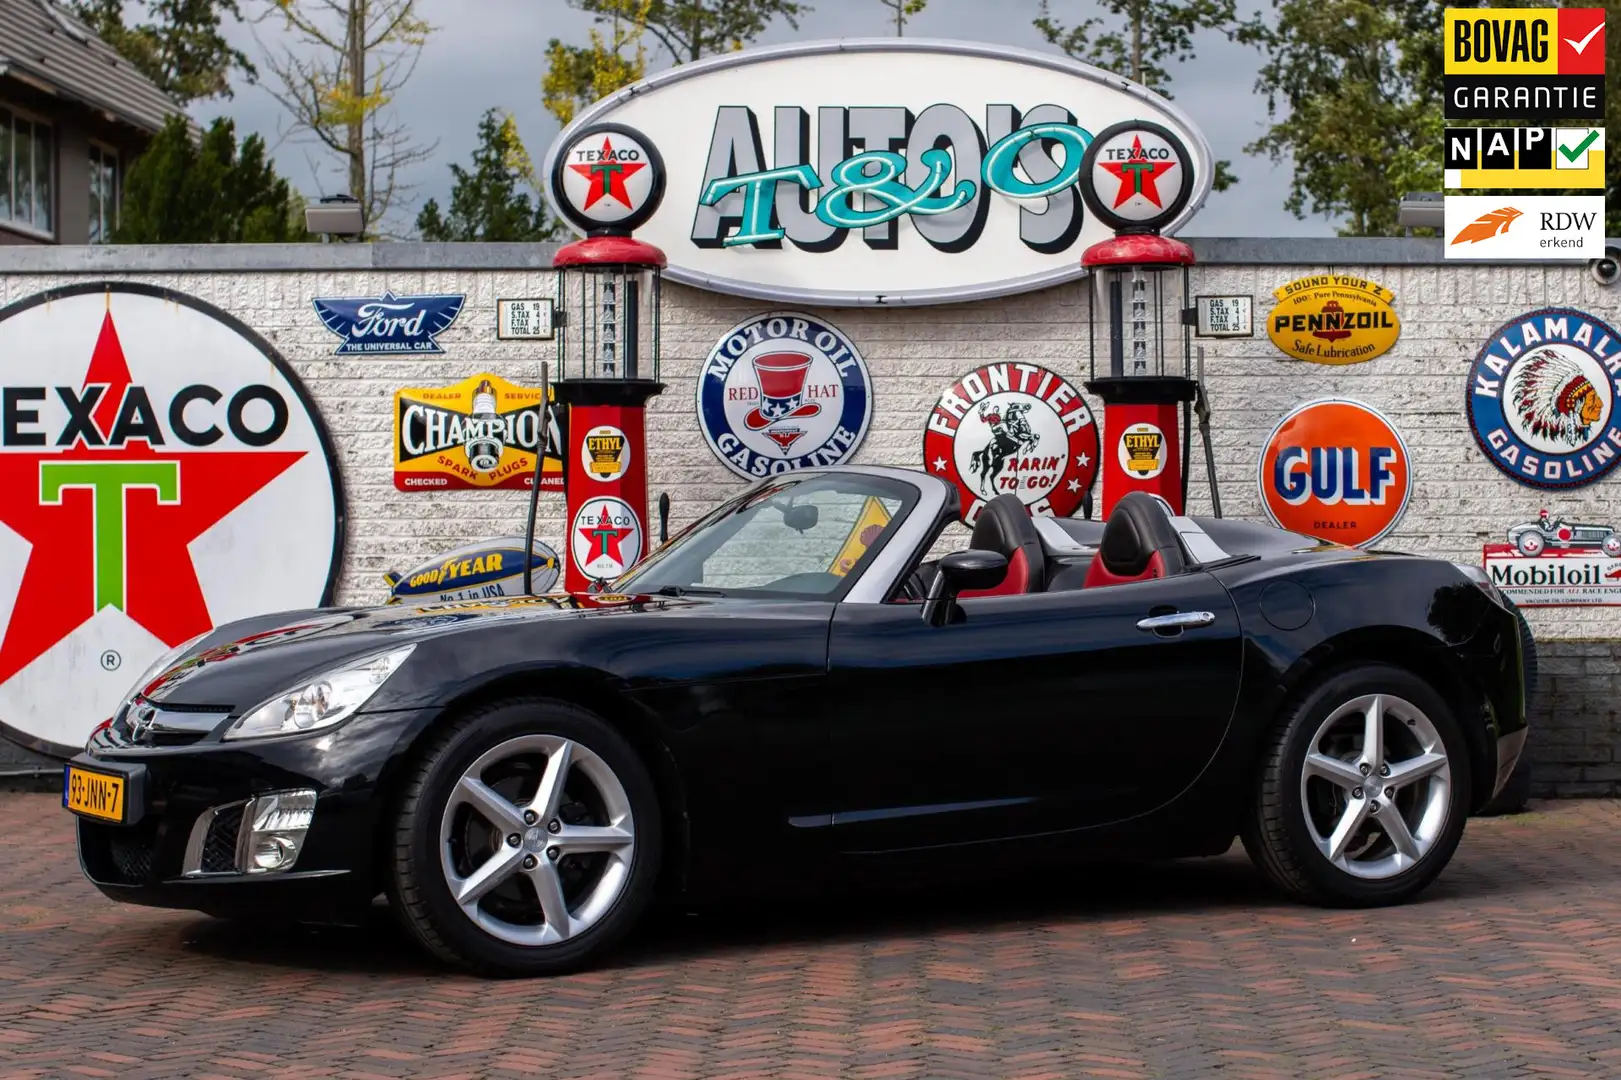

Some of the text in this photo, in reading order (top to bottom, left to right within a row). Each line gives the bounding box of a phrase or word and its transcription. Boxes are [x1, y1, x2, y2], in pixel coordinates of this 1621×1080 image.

[576, 149, 640, 162] TEXACO
[1105, 147, 1170, 160] TEXACO
[690, 103, 1084, 253] AUTO'S
[1284, 276, 1383, 295] SOUND YOUR Z
[511, 303, 525, 311] GAS
[1210, 299, 1239, 307] GAS 19
[1314, 291, 1331, 299] Pure
[1332, 291, 1377, 307] Pennsylvania
[511, 311, 540, 319] S.TAX 4
[1210, 307, 1239, 315] S.TAX 4
[1210, 315, 1228, 323] F.TAX
[351, 302, 428, 338] Ford
[511, 319, 529, 327] F.TAX
[1210, 324, 1230, 332] TOTAL
[1275, 311, 1394, 333] PENNZOIL
[511, 327, 531, 335] TOTAL
[346, 341, 433, 351] THE UNIVERSAL CAR
[708, 317, 857, 382] MOTOR OIL
[1292, 339, 1376, 358] Safe Lubrication
[729, 384, 839, 401] RED HAT
[928, 364, 1093, 437] FRONTIER
[588, 437, 622, 450] ETHYL
[1126, 435, 1160, 448] ETHYL
[1487, 427, 1621, 480] GASOLINE
[436, 455, 529, 481] SPARK PLUGS
[1007, 453, 1066, 472] RARIN'
[404, 477, 565, 486] CHECKED CLANE
[999, 476, 1018, 490] TO
[1027, 474, 1057, 490] GO!
[1274, 446, 1397, 505] GULF
[580, 515, 631, 526] TEXACO
[1313, 521, 1357, 530] DEALER
[410, 553, 503, 588] GOODYEAR
[1491, 564, 1602, 585] Mobiloil
[458, 592, 464, 600] 1
[482, 584, 505, 599] USA
[71, 773, 120, 813] 93-JNN-7
